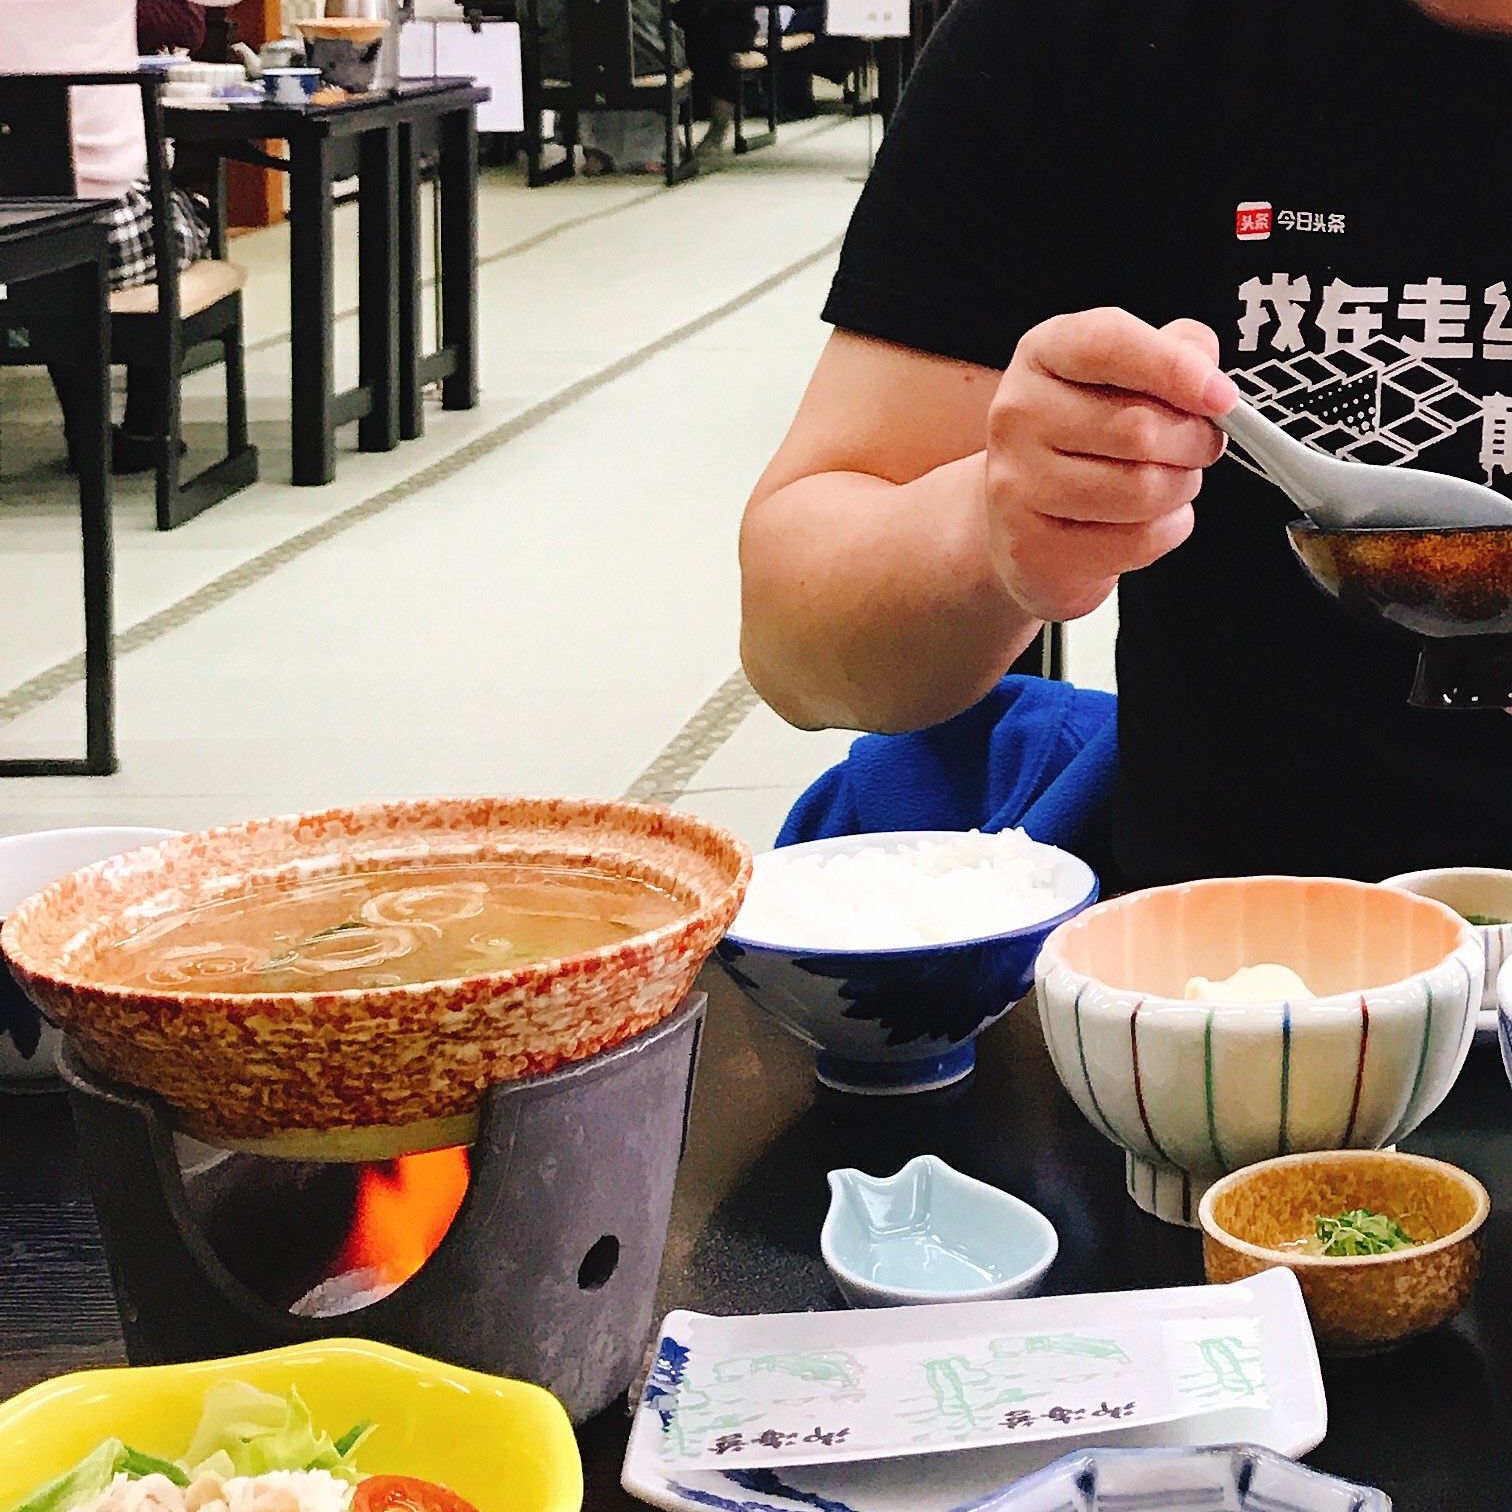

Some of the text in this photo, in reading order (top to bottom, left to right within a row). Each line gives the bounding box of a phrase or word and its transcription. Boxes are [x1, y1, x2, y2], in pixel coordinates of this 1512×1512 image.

[1241, 213, 1269, 231] 头条
[1277, 210, 1346, 234] 今日头条
